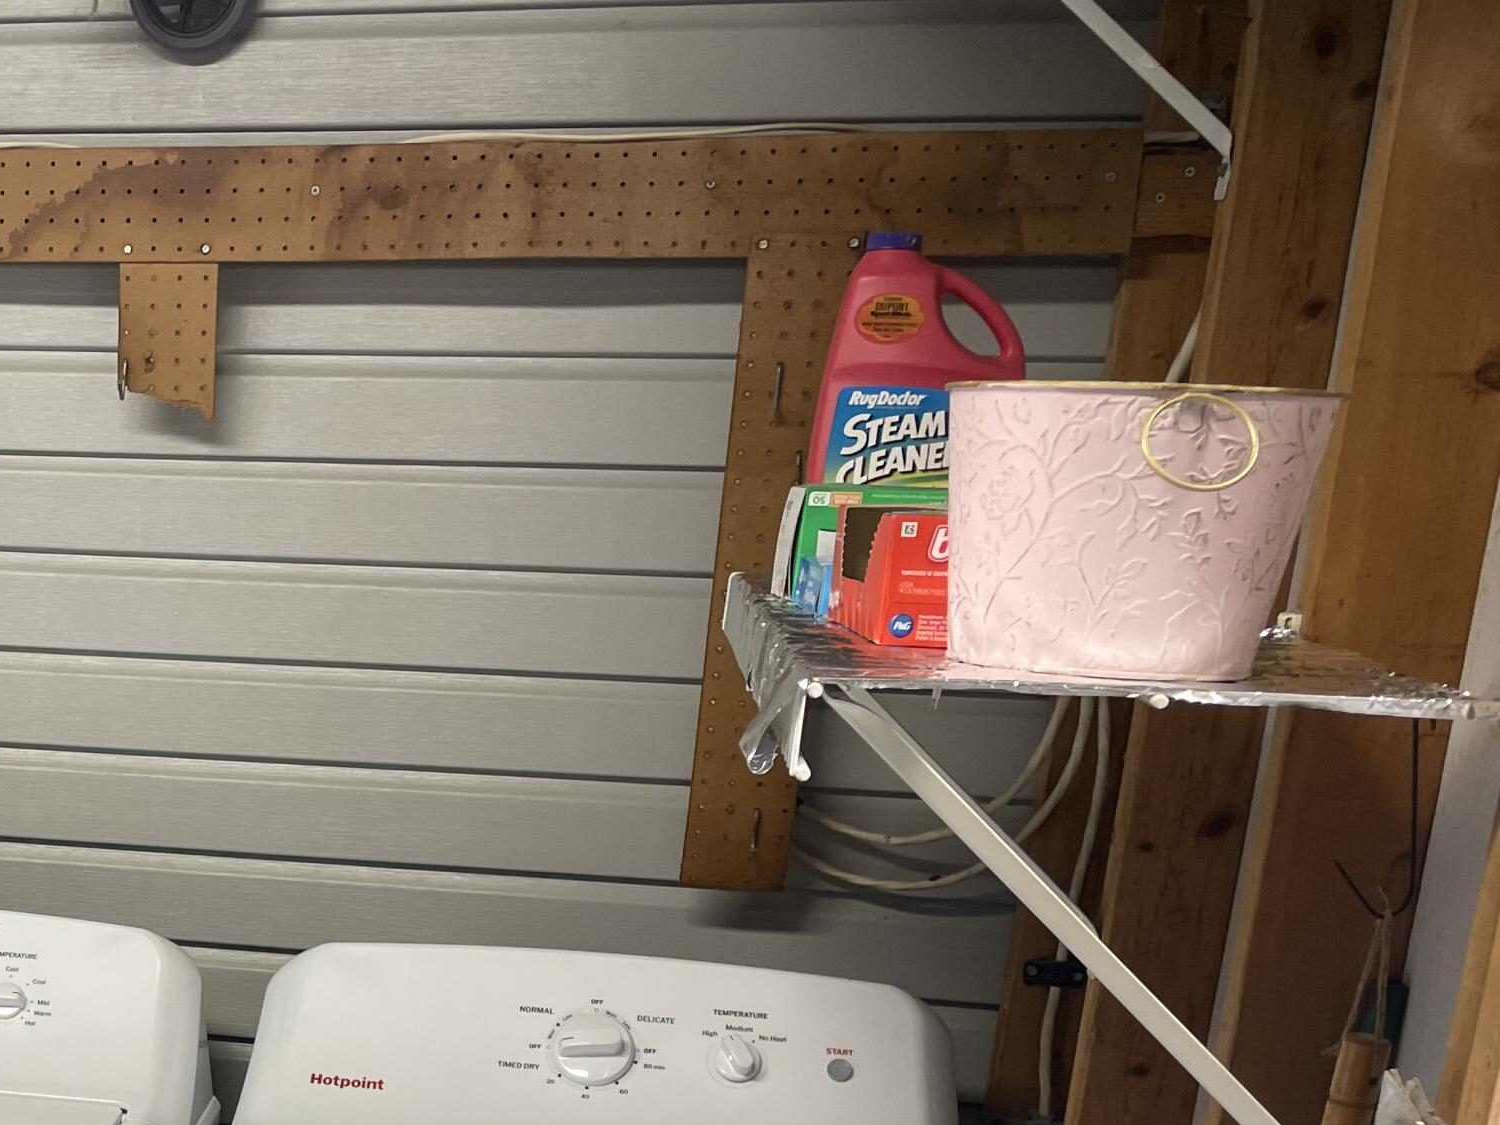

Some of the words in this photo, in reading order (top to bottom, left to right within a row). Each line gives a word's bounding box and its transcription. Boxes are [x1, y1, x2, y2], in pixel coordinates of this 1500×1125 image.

[848, 390, 926, 409] RugDoctor
[840, 410, 946, 455] STEAM
[835, 441, 949, 485] CLEANE
[5, 965, 20, 973] Cold
[591, 998, 604, 1006] OFF
[519, 1006, 555, 1015] NORMAL
[713, 1009, 769, 1020] TEMPERATURE
[636, 1015, 676, 1025] DELICATE
[701, 1029, 718, 1038] High
[725, 1024, 754, 1033] Medium
[758, 1034, 769, 1042] No
[770, 1035, 787, 1043] Heat
[826, 1047, 854, 1057] START
[497, 1060, 523, 1070] TIMED
[523, 1062, 540, 1071] DRY
[310, 1073, 385, 1090] Hotpoint
